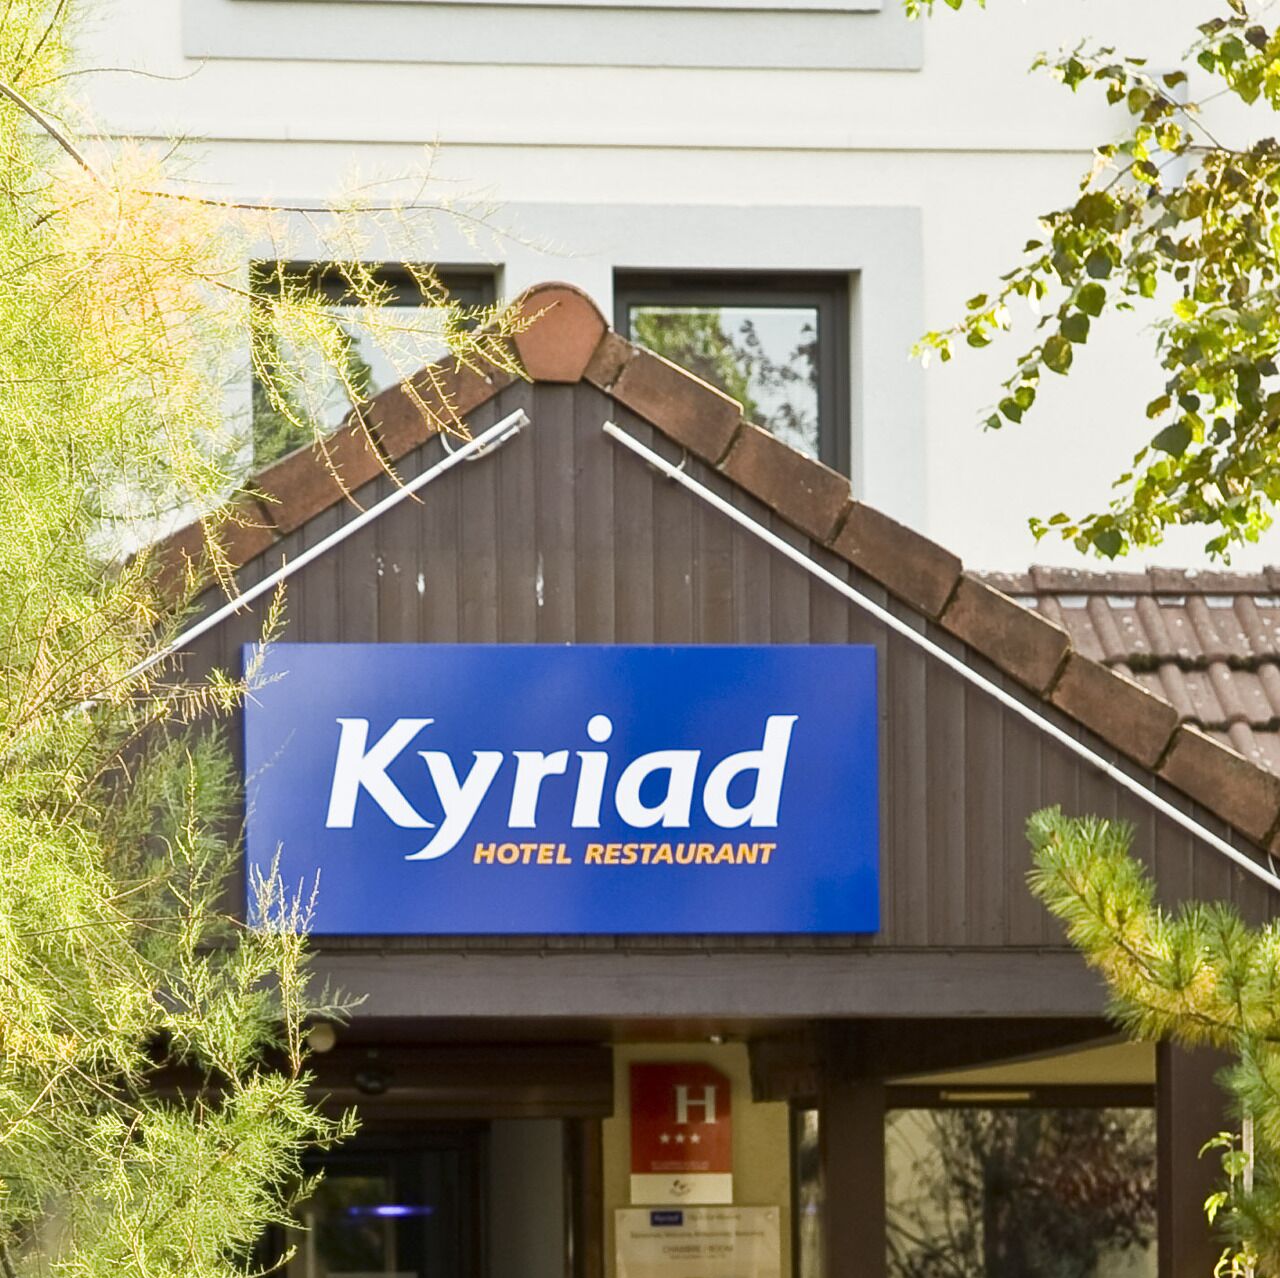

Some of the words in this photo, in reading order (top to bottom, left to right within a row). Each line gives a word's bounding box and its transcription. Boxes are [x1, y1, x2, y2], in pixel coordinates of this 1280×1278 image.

[326, 714, 799, 860] Kyriad
[473, 842, 572, 865] HOTEL
[583, 842, 777, 865] RESTAURANT
[676, 1085, 717, 1125] H
